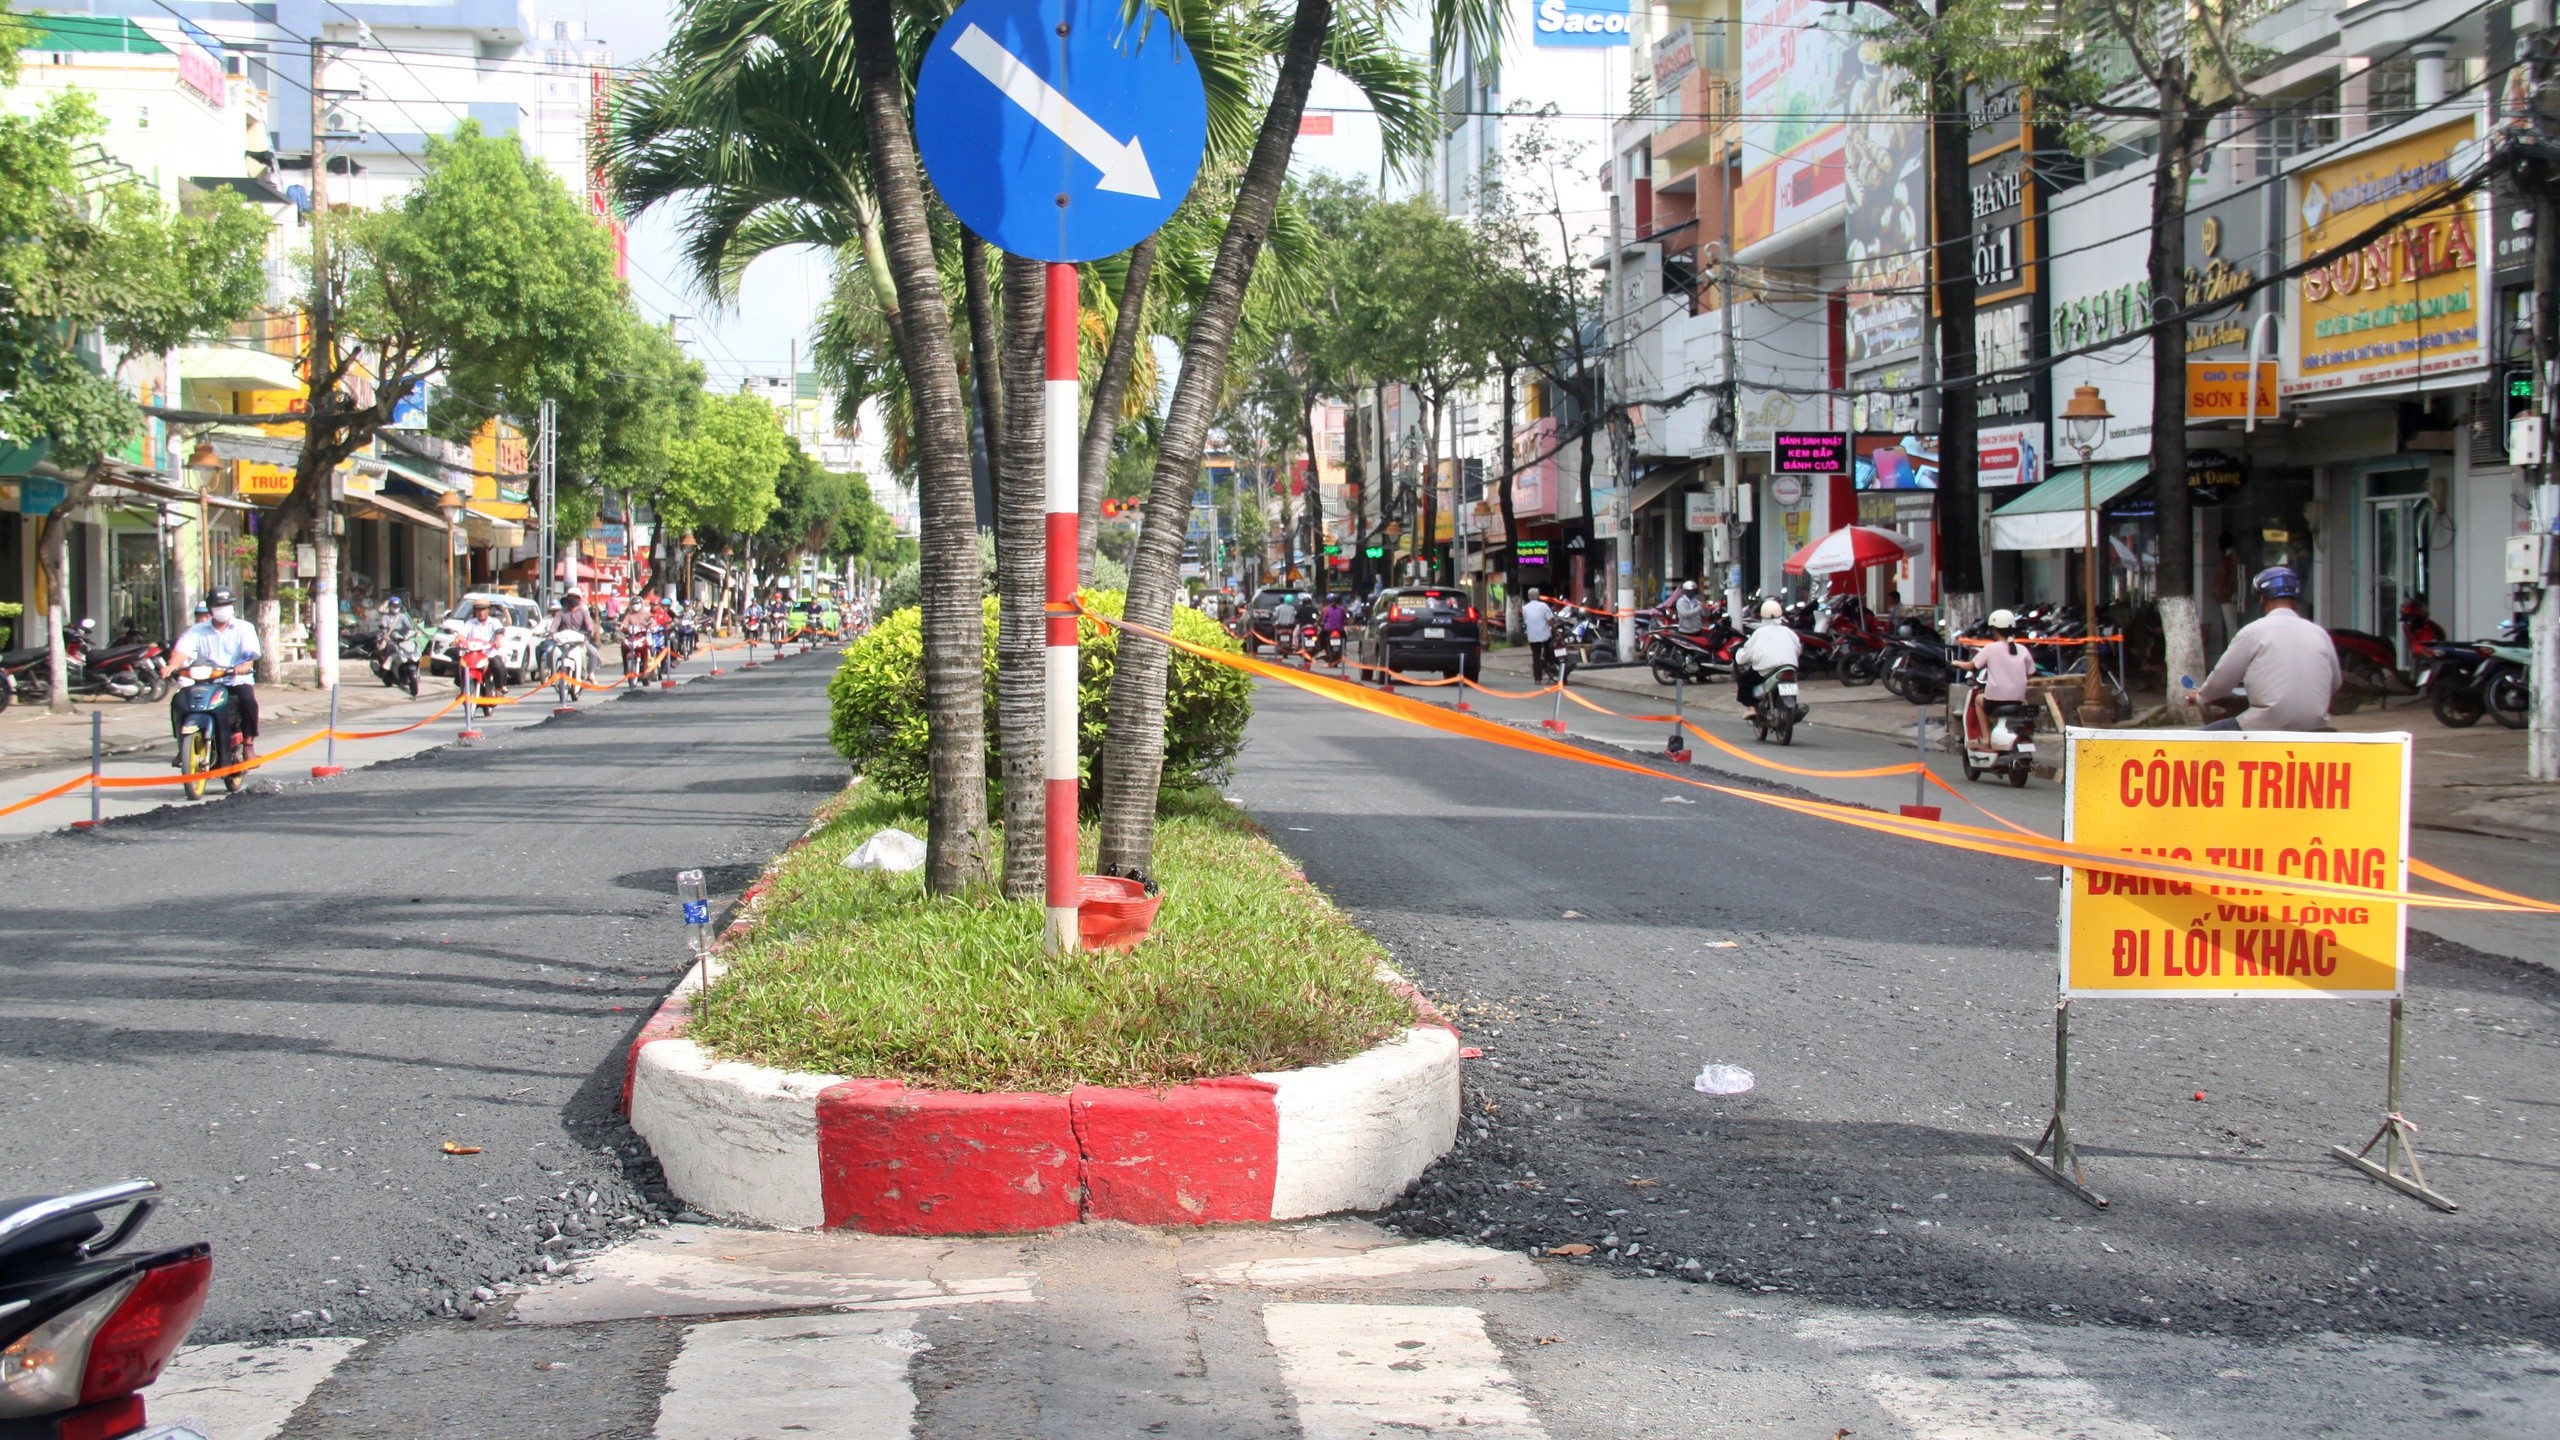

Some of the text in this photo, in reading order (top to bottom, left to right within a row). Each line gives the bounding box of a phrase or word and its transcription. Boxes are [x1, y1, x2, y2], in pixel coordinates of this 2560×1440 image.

[1974, 223, 1998, 286] ỔI
[2193, 389, 2233, 408] SƠN
[1779, 435, 1801, 446] BÁNH
[1802, 436, 1821, 446] SINH
[1787, 449, 1810, 458] KEM
[1783, 459, 1812, 470] BÁNH
[251, 473, 289, 489] TRÚC
[2119, 749, 2352, 810] CÔNG TRÌNH
[2278, 836, 2385, 895] CÔNG
[2217, 904, 2270, 923] VUI
[2112, 929, 2149, 977] ĐI
[2163, 911, 2221, 977] LỐI
